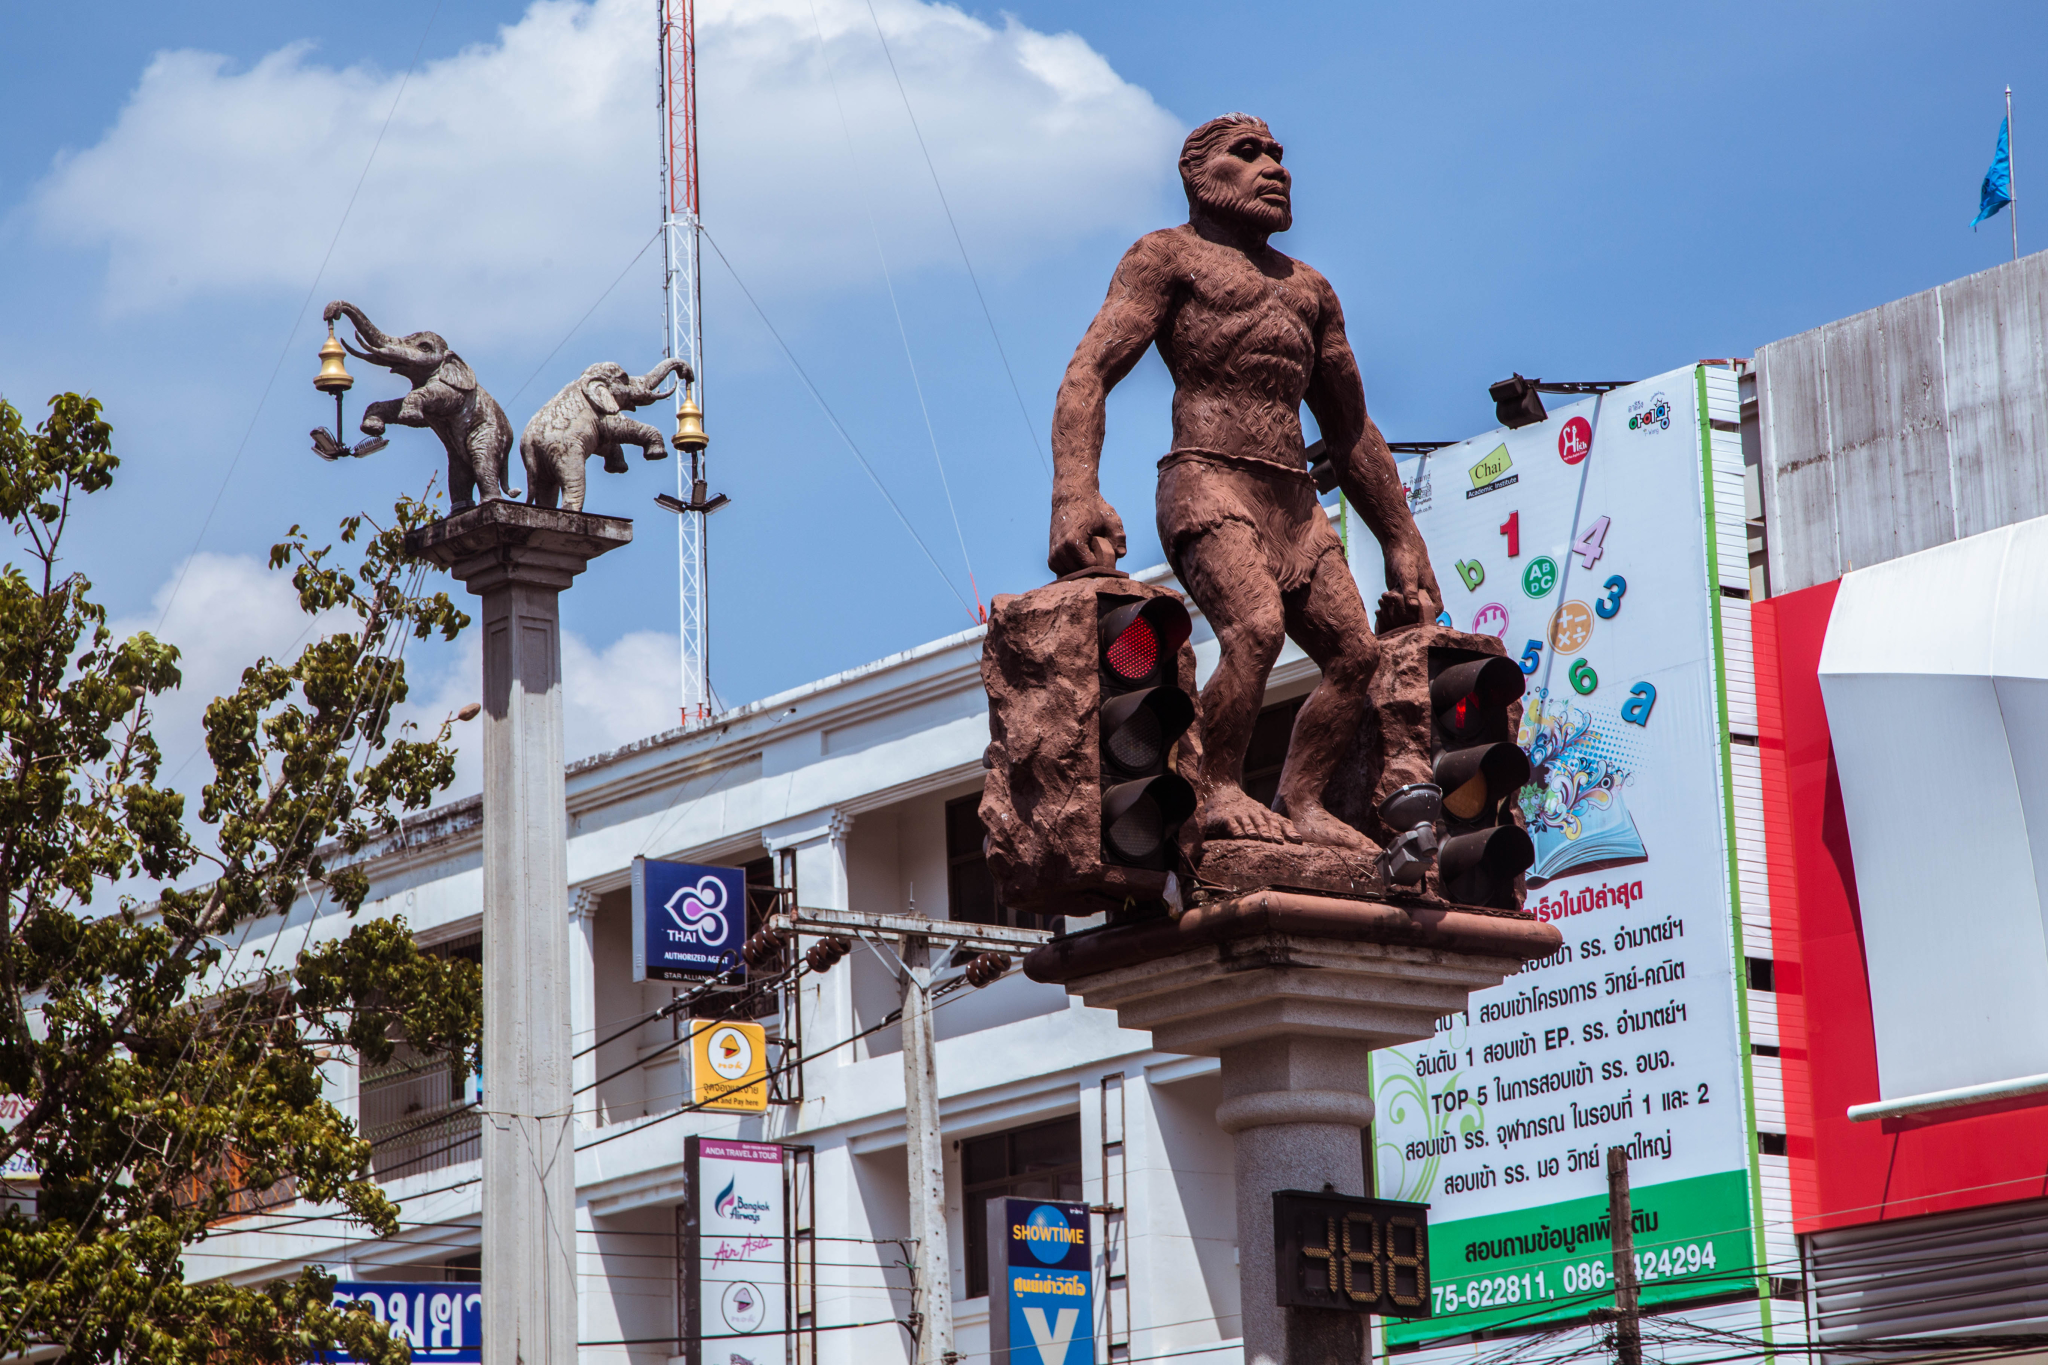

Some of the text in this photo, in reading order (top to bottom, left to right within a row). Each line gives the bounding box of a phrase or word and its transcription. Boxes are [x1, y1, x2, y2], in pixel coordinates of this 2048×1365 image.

[1475, 458, 1502, 479] Chai
[1468, 477, 1518, 498] Academic Institute
[1500, 510, 1520, 557] 1
[1572, 515, 1611, 570] 4
[1455, 558, 1485, 592] b
[1595, 575, 1627, 619] 3
[1519, 639, 1543, 675] 5
[1568, 658, 1598, 695] 6
[1621, 681, 1656, 727] a
[667, 929, 697, 943] THAI
[1580, 938, 1606, 959] รร.
[1614, 915, 1683, 951] อำมาตย์ฯ
[664, 952, 706, 963] AUTHORIZED
[1479, 981, 1597, 1023] สอบเข้าโครงการ
[1605, 959, 1685, 995] วิทย์-คณิต
[1416, 999, 1686, 1077] อันดับ 1 สอบเข้า EP. รร. อำมาตย์ฯ
[718, 1061, 743, 1069] nok
[1431, 1050, 1675, 1114] TOP 5 ในการสอบเข้า รร. อบจ.
[720, 1097, 732, 1105] and
[734, 1098, 744, 1107] Pay
[745, 1099, 759, 1107] here
[1405, 1130, 1457, 1161] สอบเข้า
[1464, 1130, 1489, 1150] รร.
[1570, 1089, 1633, 1129] ในรอบที่
[1642, 1094, 1650, 1115] 1
[1662, 1089, 1689, 1111] และ
[1697, 1083, 1710, 1105] 2
[705, 1147, 725, 1156] ANDA
[725, 1148, 752, 1158] TRAVEL
[758, 1151, 777, 1160] TOUR
[1444, 1129, 1672, 1195] สอบเข้า รร. มอ วิทย์ ดใหญ่
[730, 1207, 760, 1224] Airways
[737, 1196, 770, 1213] Bangkok
[712, 1233, 773, 1270] Air Asia
[1563, 1241, 1717, 1294] 086-424294
